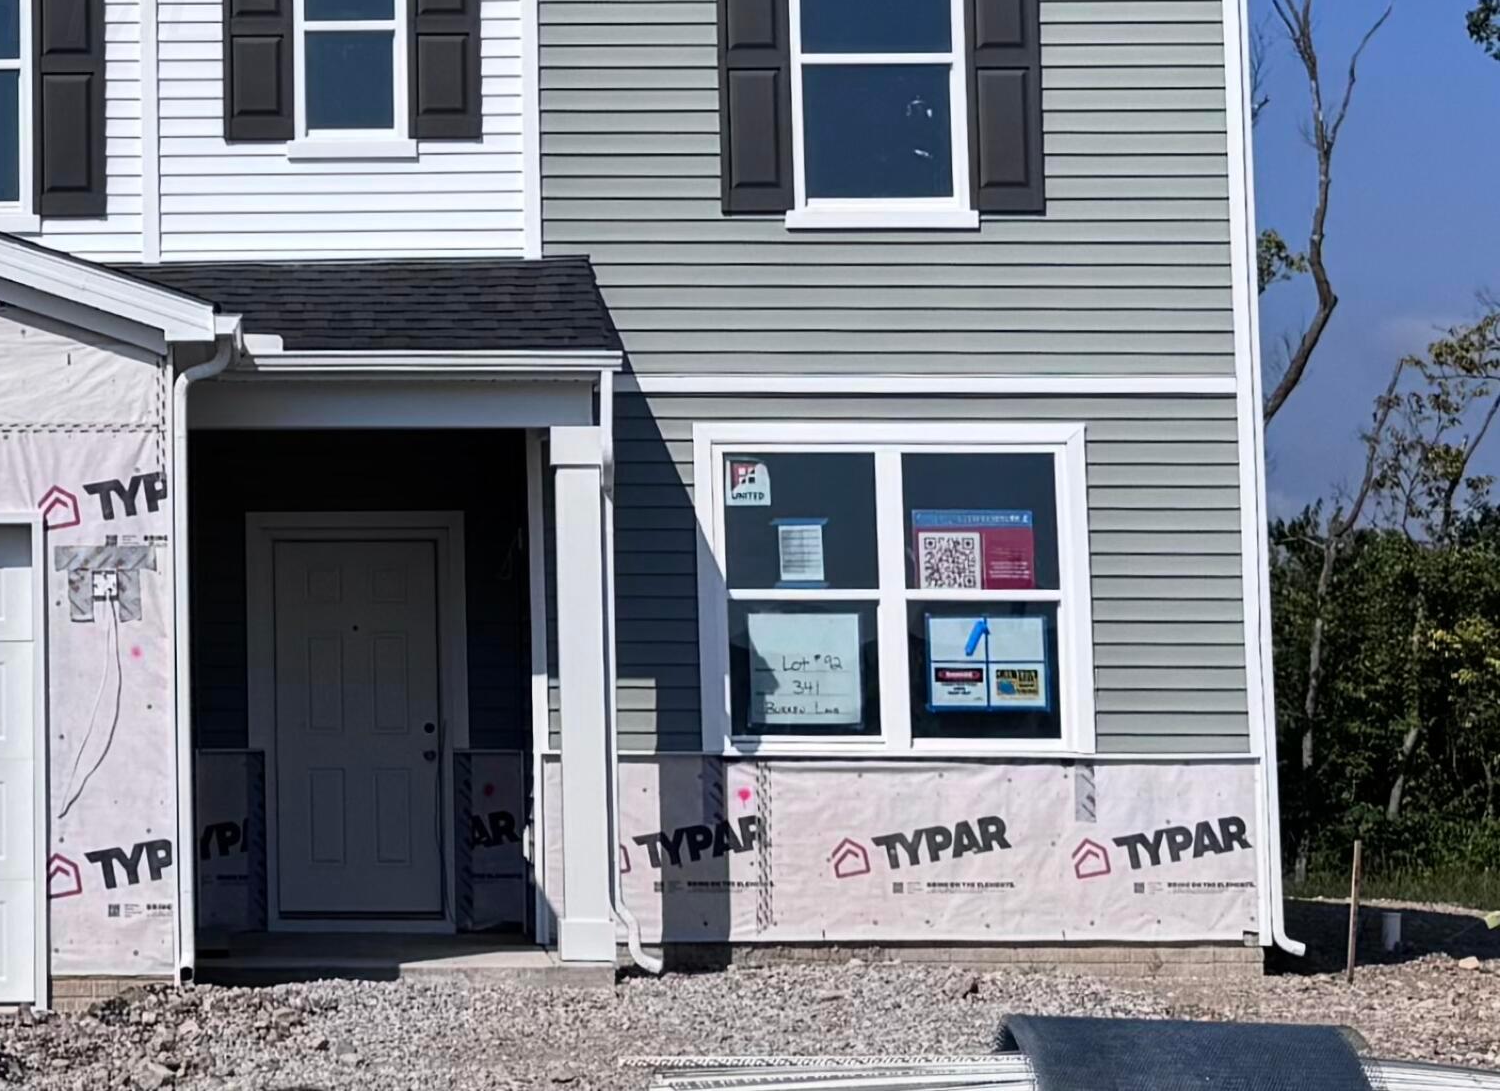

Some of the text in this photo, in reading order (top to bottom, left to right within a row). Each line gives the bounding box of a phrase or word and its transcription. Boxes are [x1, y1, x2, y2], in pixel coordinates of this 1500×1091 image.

[82, 471, 168, 521] TYP
[731, 492, 765, 500] UNITED
[782, 655, 810, 672] Lot
[792, 679, 820, 696] 341
[200, 817, 249, 860] YP
[871, 815, 1012, 869] TYPAR
[1111, 816, 1253, 870] TYPAR
[83, 838, 173, 890] TYP
